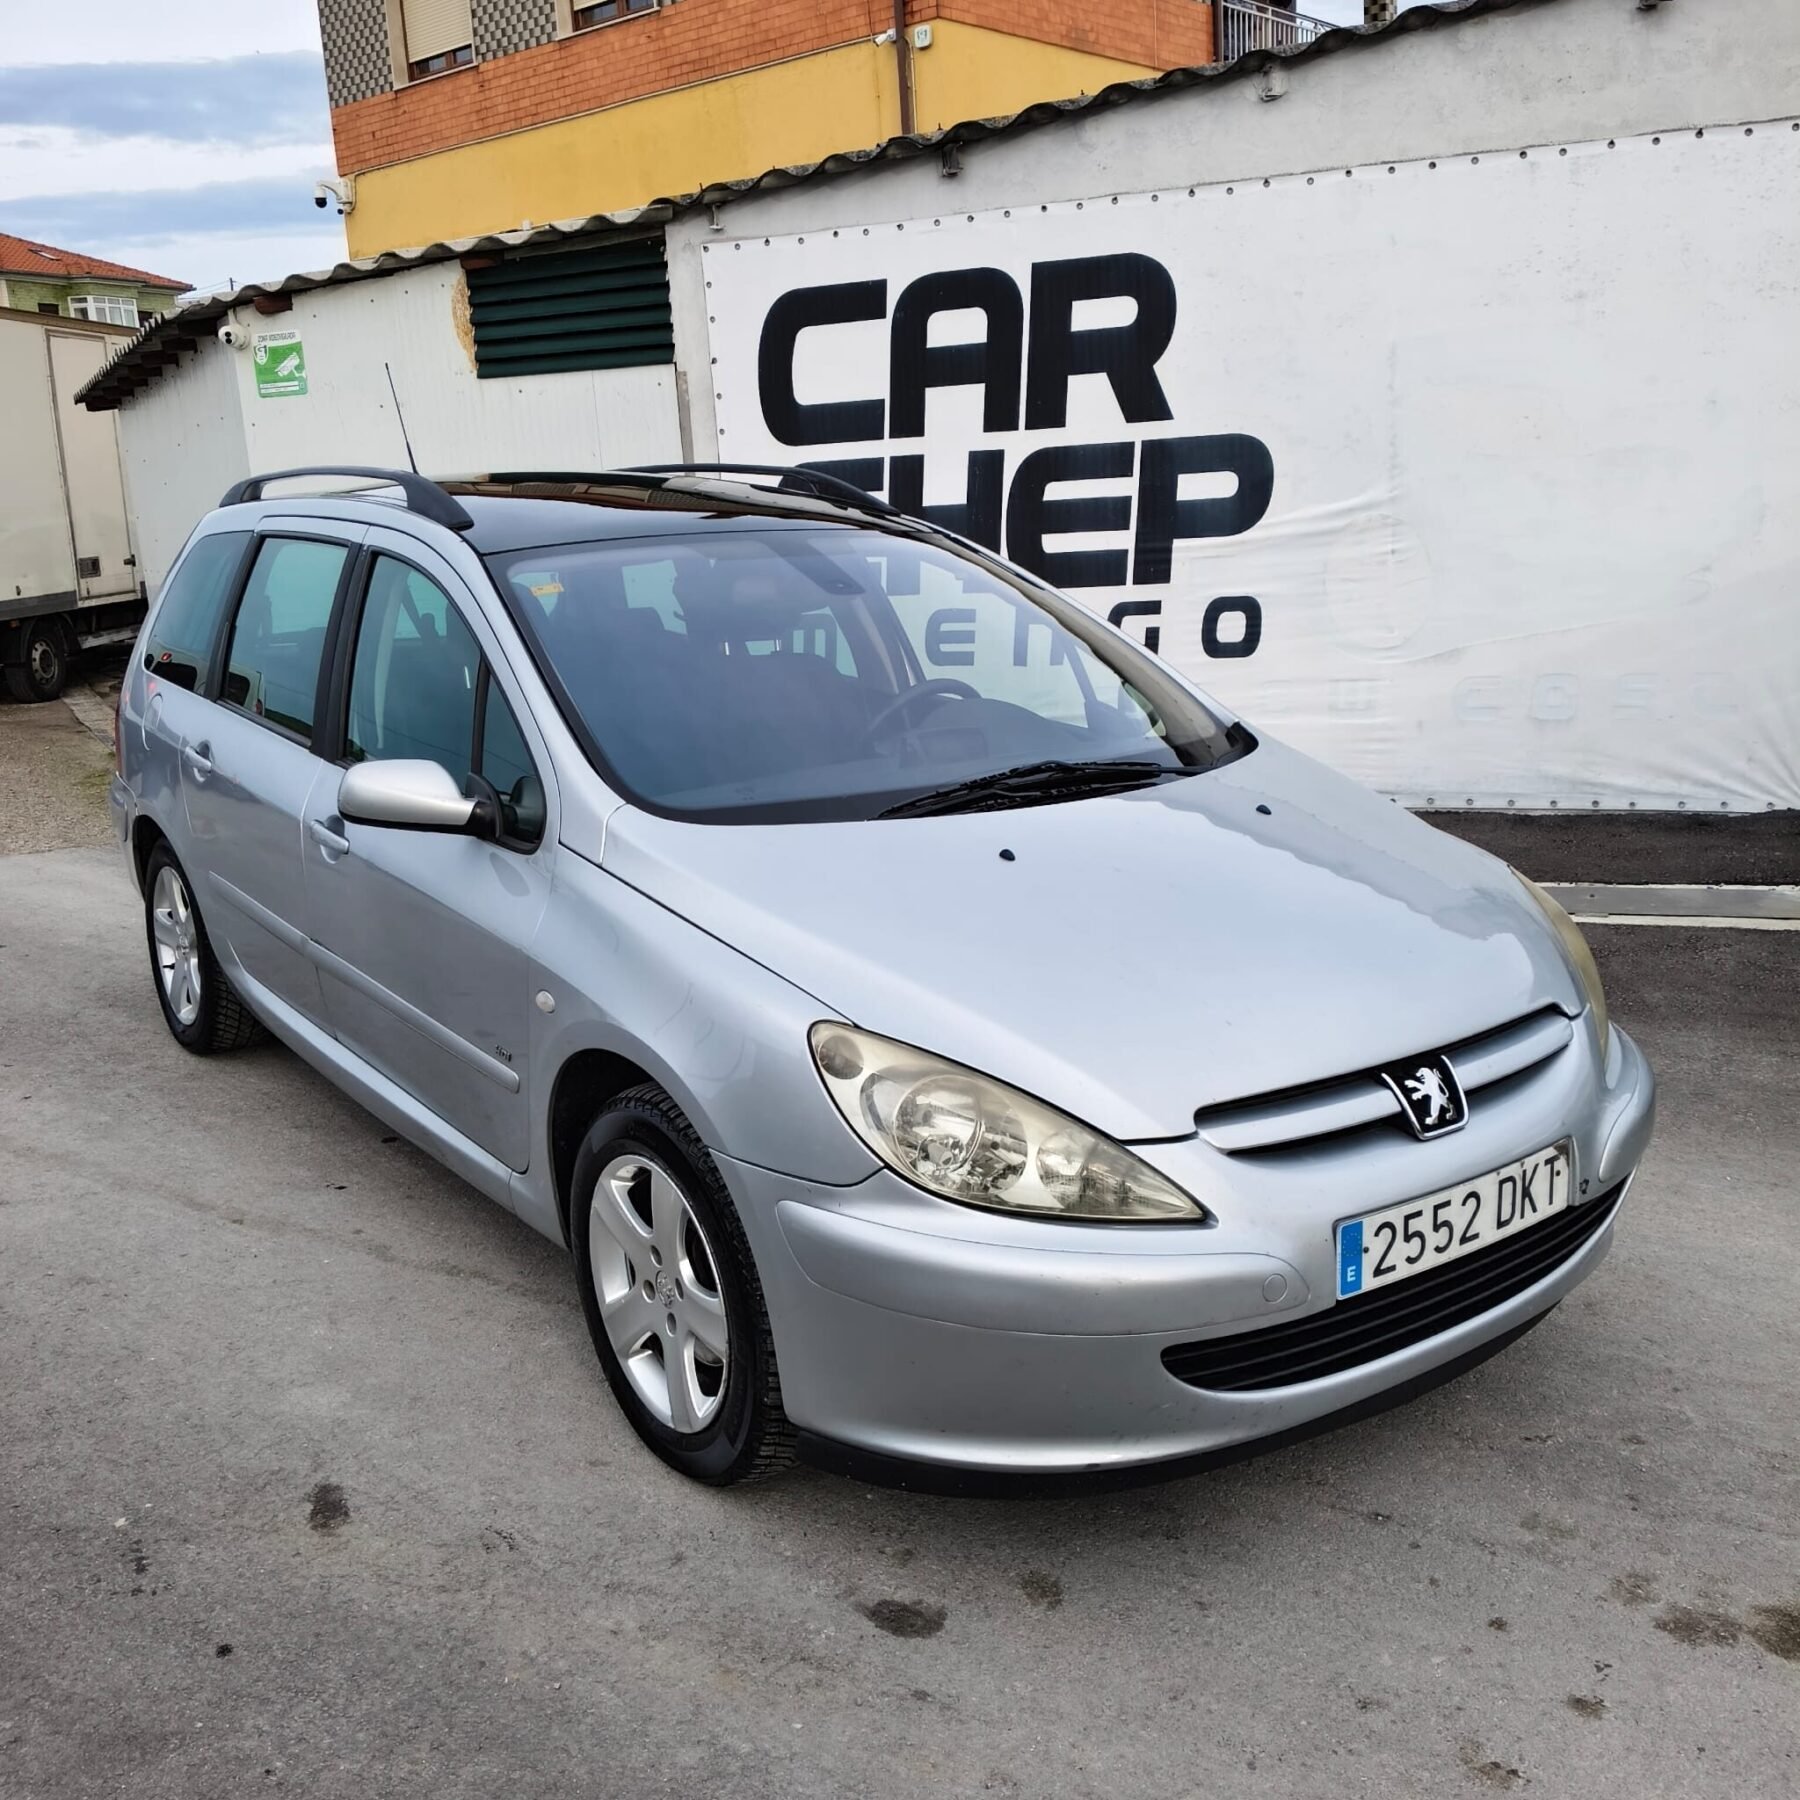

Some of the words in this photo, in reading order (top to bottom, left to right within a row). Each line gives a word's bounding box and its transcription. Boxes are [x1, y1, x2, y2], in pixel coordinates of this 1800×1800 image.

[758, 252, 1177, 447] CAR
[1346, 1265, 1357, 1283] E
[1372, 1190, 1482, 1278] 2552
[1496, 1154, 1562, 1231] DKT
